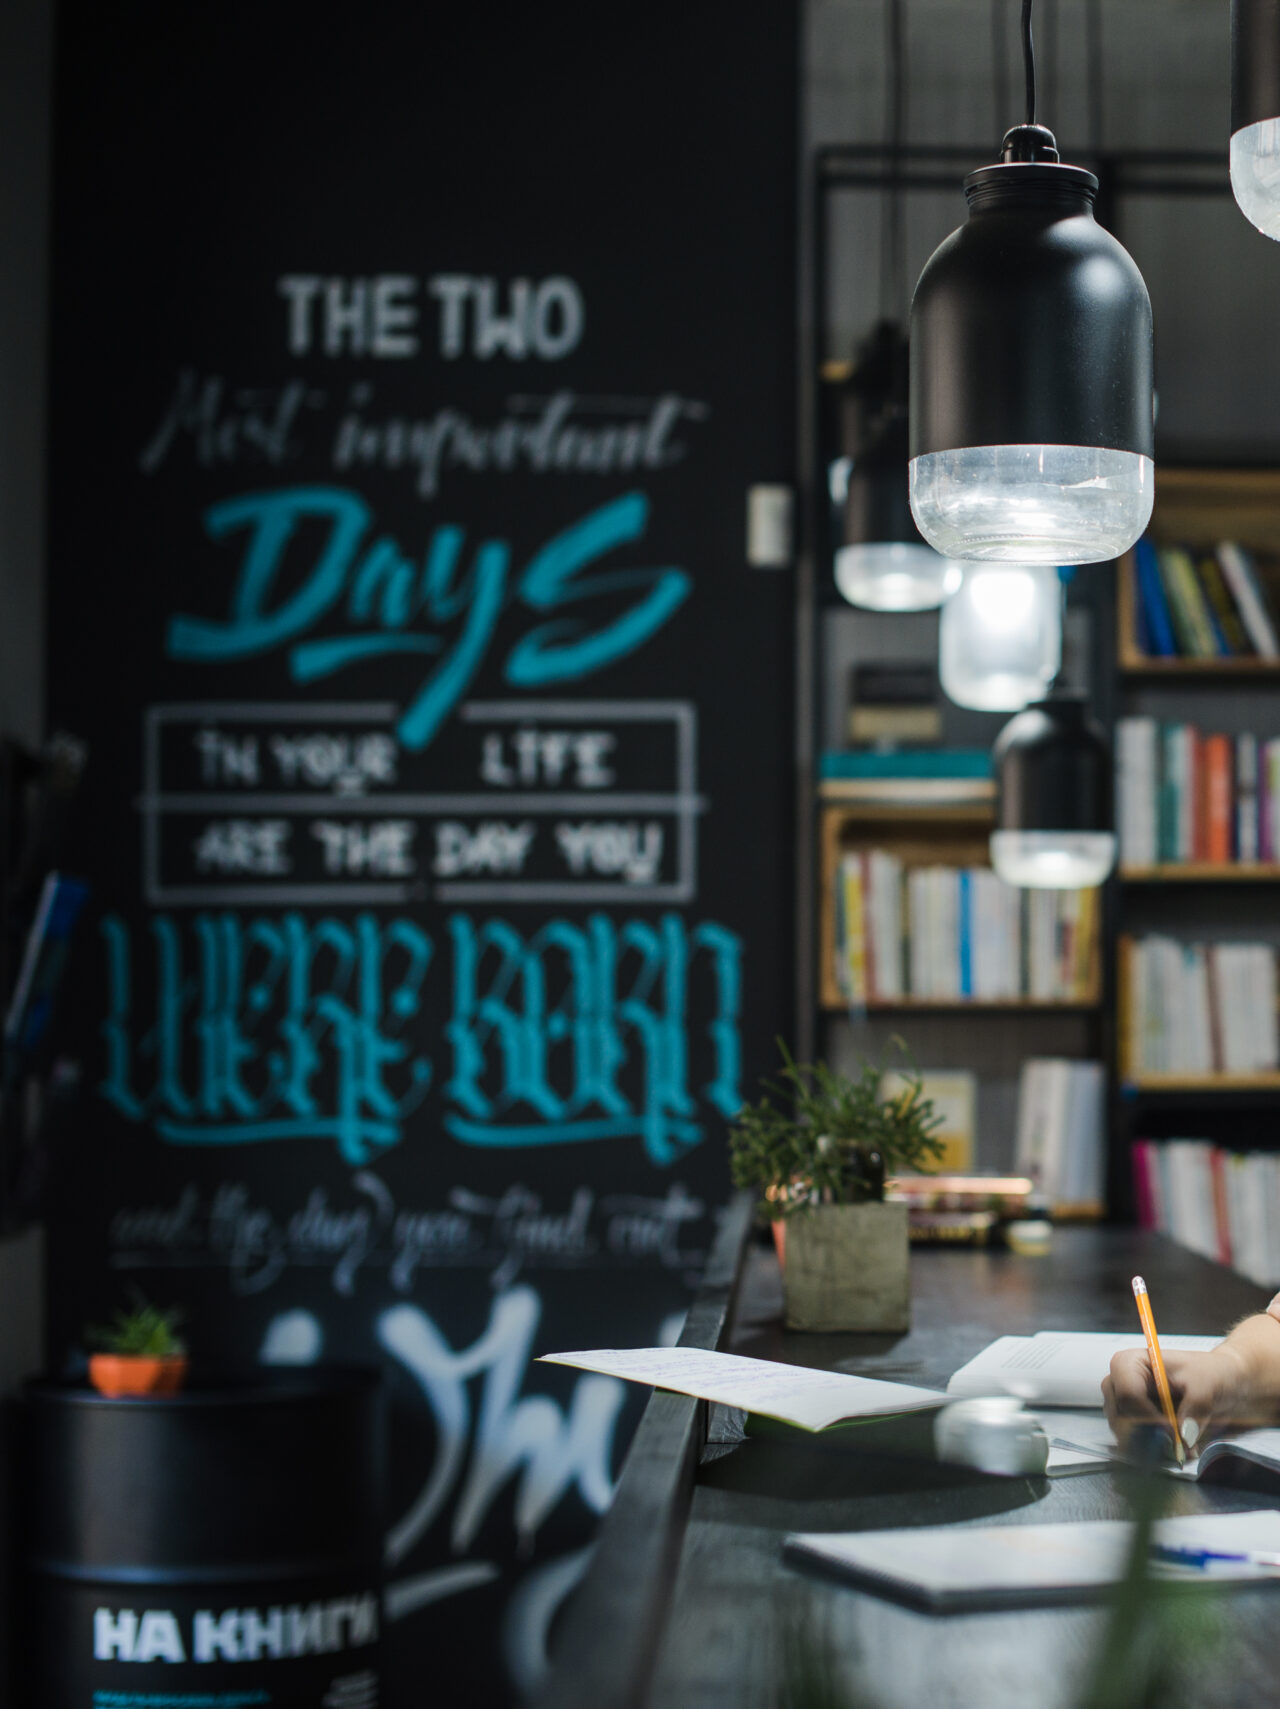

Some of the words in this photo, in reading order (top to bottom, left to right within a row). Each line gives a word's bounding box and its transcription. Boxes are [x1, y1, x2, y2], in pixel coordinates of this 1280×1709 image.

[280, 275, 420, 357] THE
[426, 275, 584, 359] TWO
[331, 379, 711, 499] important
[268, 730, 398, 798] YOUR
[480, 728, 616, 788] LIFE
[192, 818, 293, 877] ARE
[310, 818, 418, 877] THE
[432, 818, 537, 877] DAY
[553, 818, 665, 885] YOU
[93, 1606, 187, 1664] НА
[191, 1589, 379, 1664] КНИГИ
